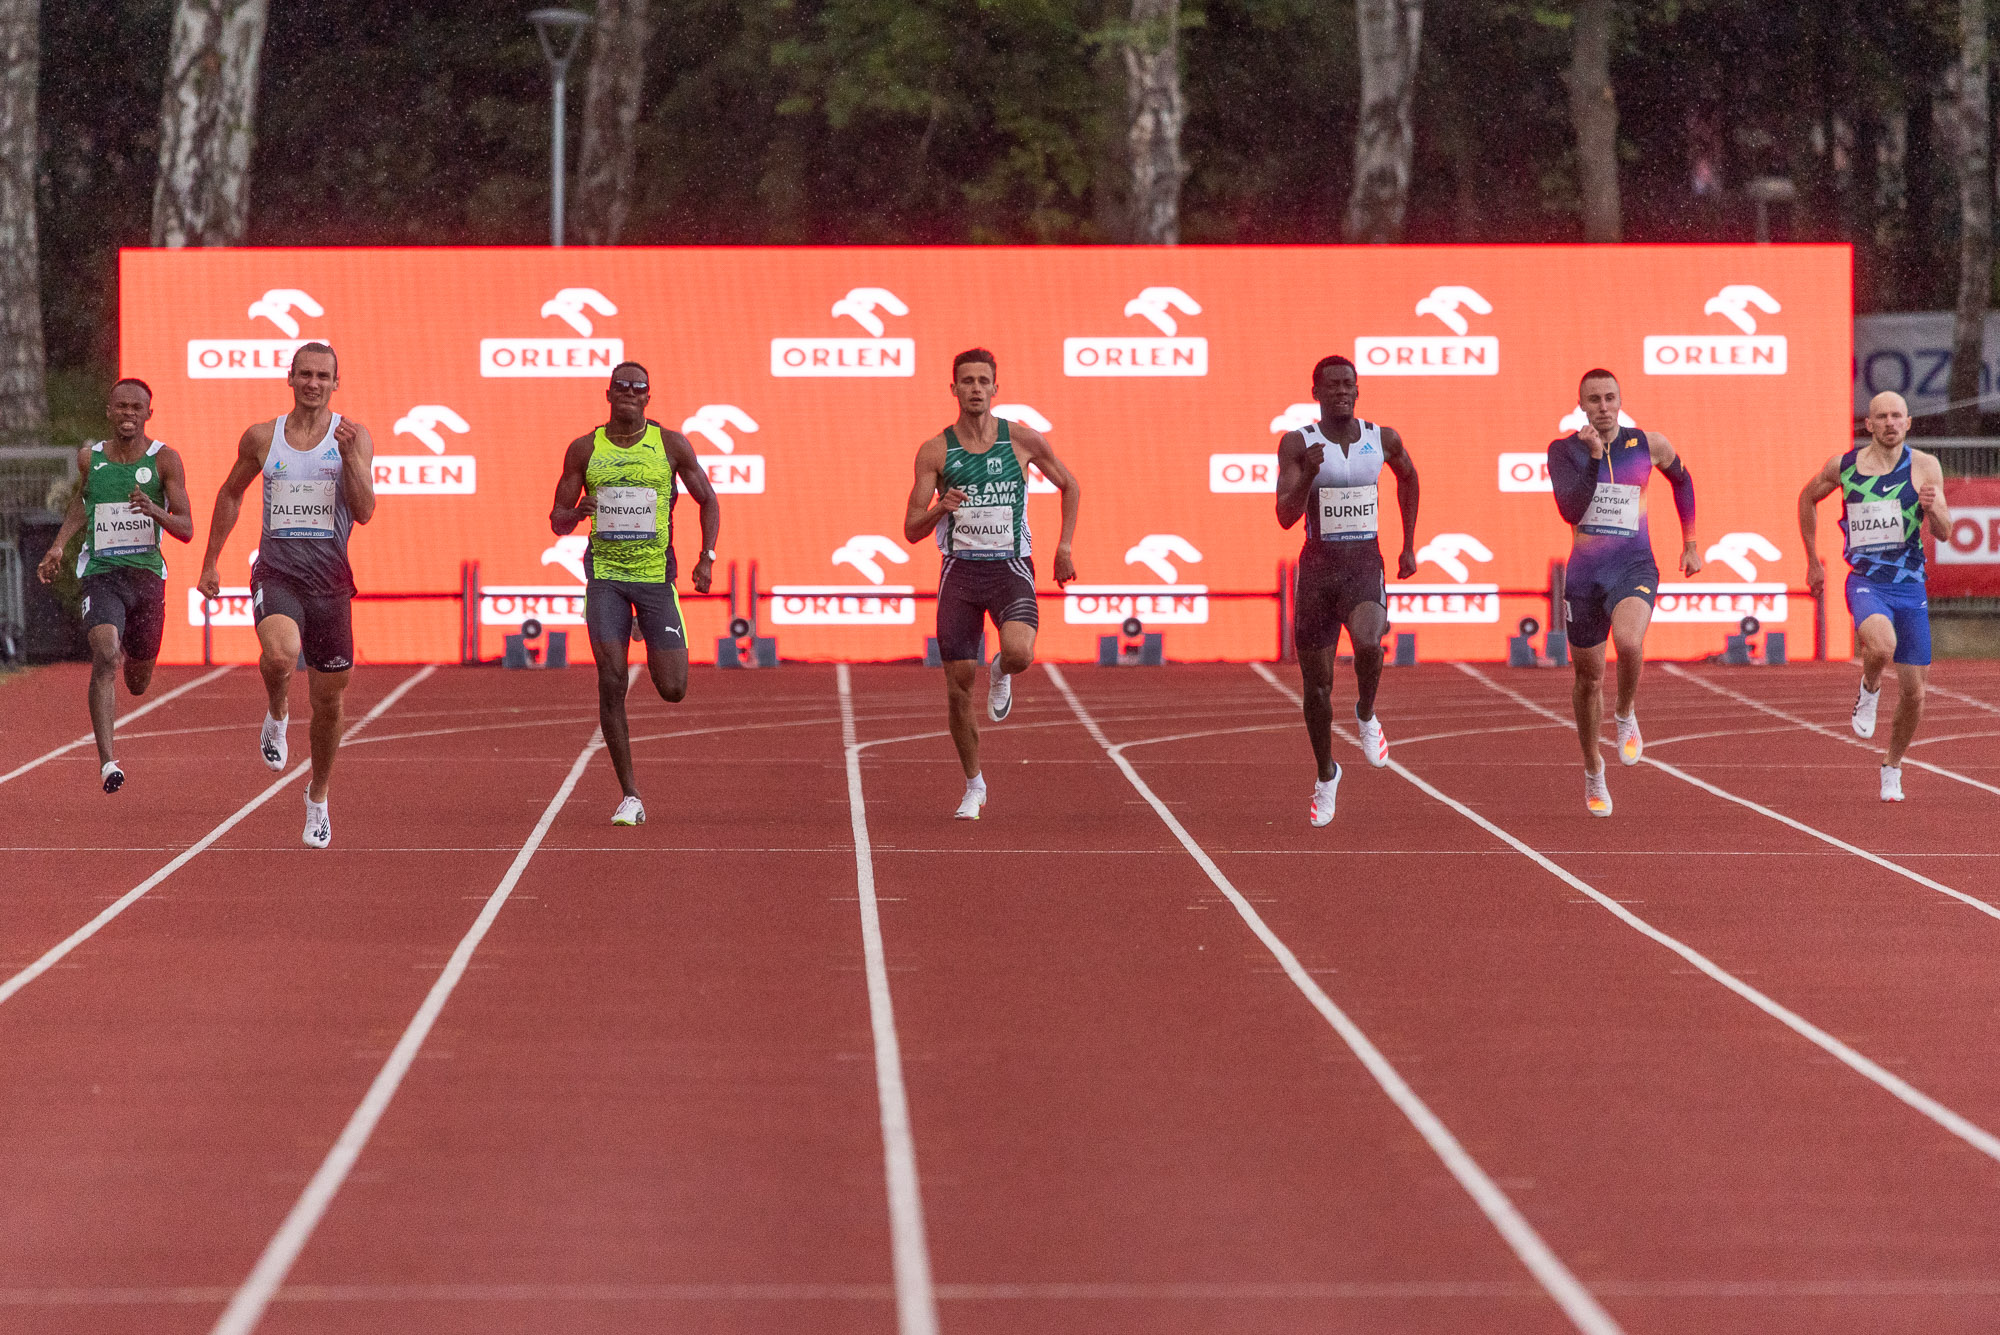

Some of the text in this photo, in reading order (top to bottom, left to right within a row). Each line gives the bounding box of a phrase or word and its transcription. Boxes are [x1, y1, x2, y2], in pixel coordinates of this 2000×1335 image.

[199, 349, 291, 368] ORLE
[493, 348, 609, 366] ORLEN
[784, 348, 900, 366] ORLEN
[1077, 348, 1193, 366] ORLEN
[1368, 347, 1484, 365] ORLEN
[1656, 346, 1773, 364] ORLEN
[374, 466, 463, 484] RLEN
[983, 481, 1018, 494] AWF
[1592, 495, 1630, 505] OŁTYSIAK
[272, 504, 333, 515] ZALEWSKI
[599, 505, 652, 515] BONEVACIA
[1324, 503, 1375, 517] BURNET
[1595, 506, 1622, 516] Daniel
[96, 518, 151, 532] AL YASSIN
[955, 524, 1010, 535] KOWALUK
[1851, 516, 1899, 532] BUZAŁA
[492, 596, 583, 614] ORLE
[783, 596, 902, 614] ORLEN
[1076, 596, 1195, 614] ORLEN
[1388, 596, 1486, 613] RLEN
[1656, 595, 1775, 612] ORLEN
